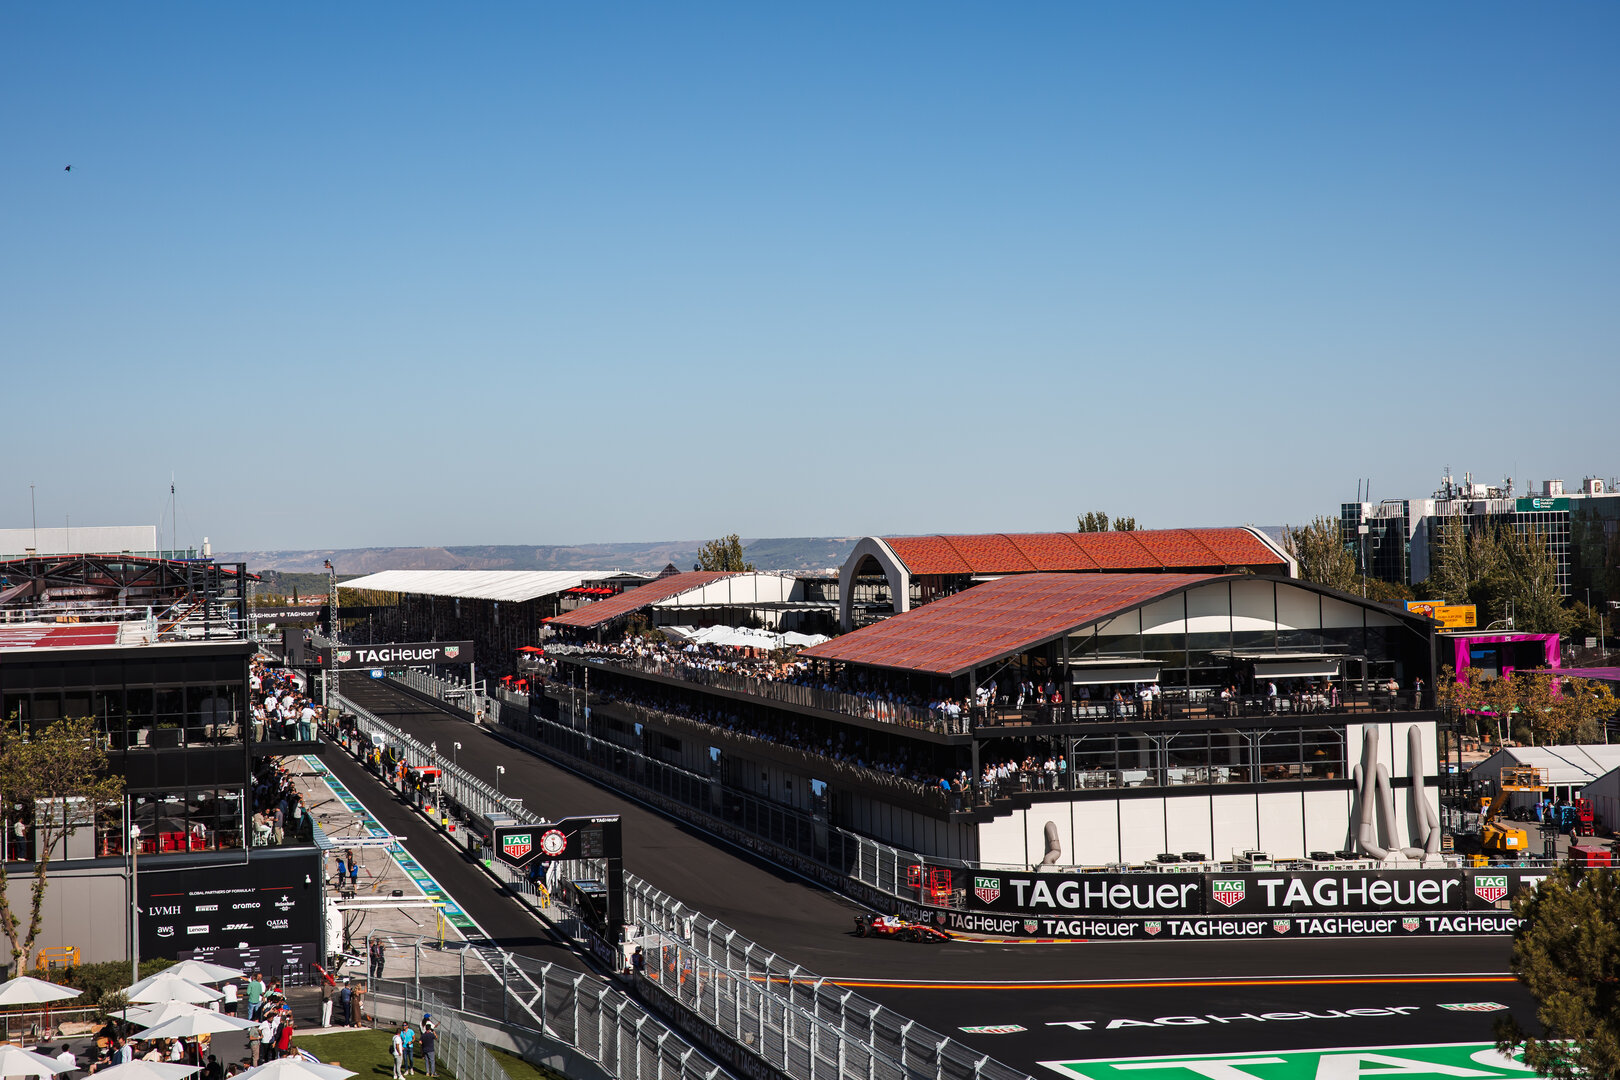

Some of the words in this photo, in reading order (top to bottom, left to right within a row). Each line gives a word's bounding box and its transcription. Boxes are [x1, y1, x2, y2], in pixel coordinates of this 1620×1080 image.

[356, 648, 440, 662] TAGHeuer
[506, 836, 529, 844] TAG
[504, 845, 531, 858] HEUER
[976, 879, 998, 888] TAG
[1216, 881, 1242, 891] TAG
[1477, 878, 1504, 886] TAG
[976, 888, 999, 902] HEUER
[1010, 880, 1198, 909] TAGHeuer
[1214, 891, 1245, 905] HEUER
[1257, 878, 1460, 906] TAGHeuer
[1476, 888, 1506, 902] HEUER
[150, 905, 181, 916] LVMH
[897, 902, 934, 922] TAGHeuer
[949, 913, 1019, 933] TAGHeuer
[1043, 920, 1139, 936] TAGHeuer
[1167, 920, 1267, 935] TAGHeuer
[1296, 918, 1397, 934] TAGHeuer
[1425, 917, 1527, 932] TAGHeuer
[1045, 1006, 1419, 1031] TAGHeuer
